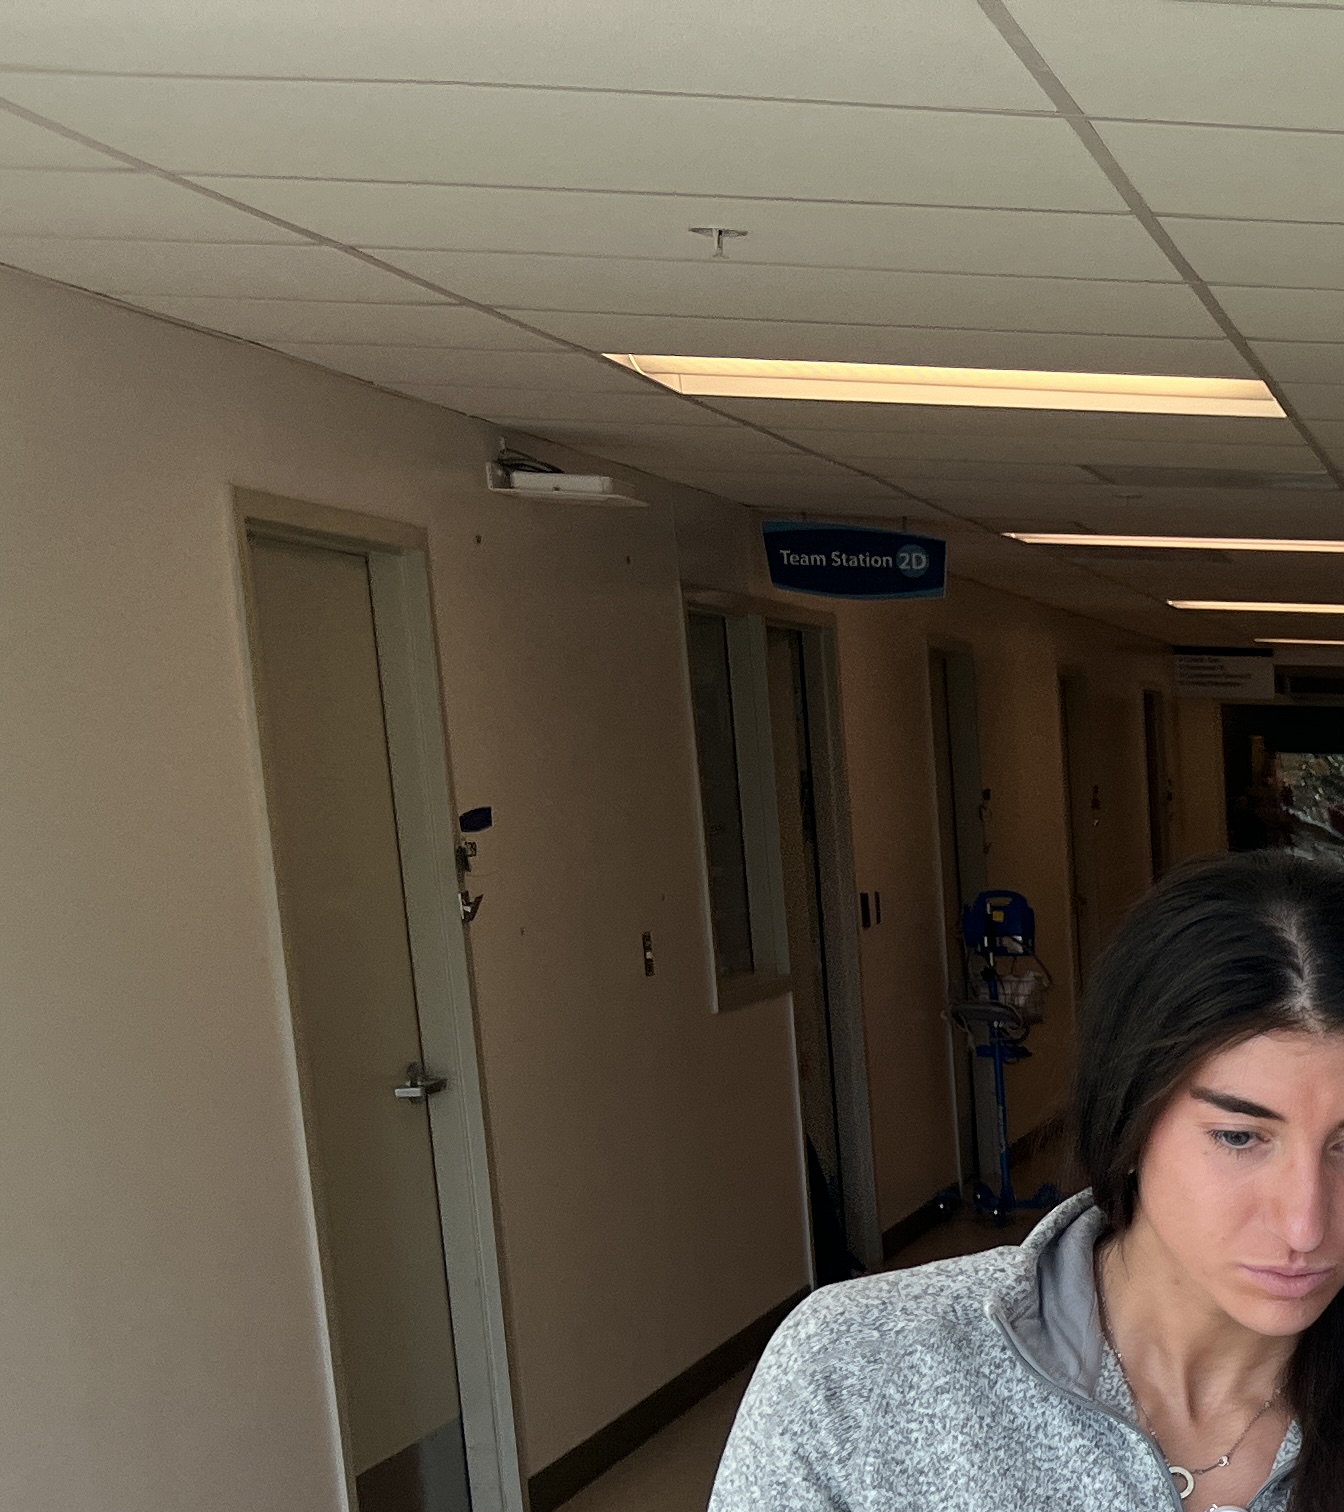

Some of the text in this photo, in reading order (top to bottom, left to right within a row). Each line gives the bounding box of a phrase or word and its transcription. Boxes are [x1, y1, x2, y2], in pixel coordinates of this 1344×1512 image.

[780, 549, 928, 570] Team Station 2D
